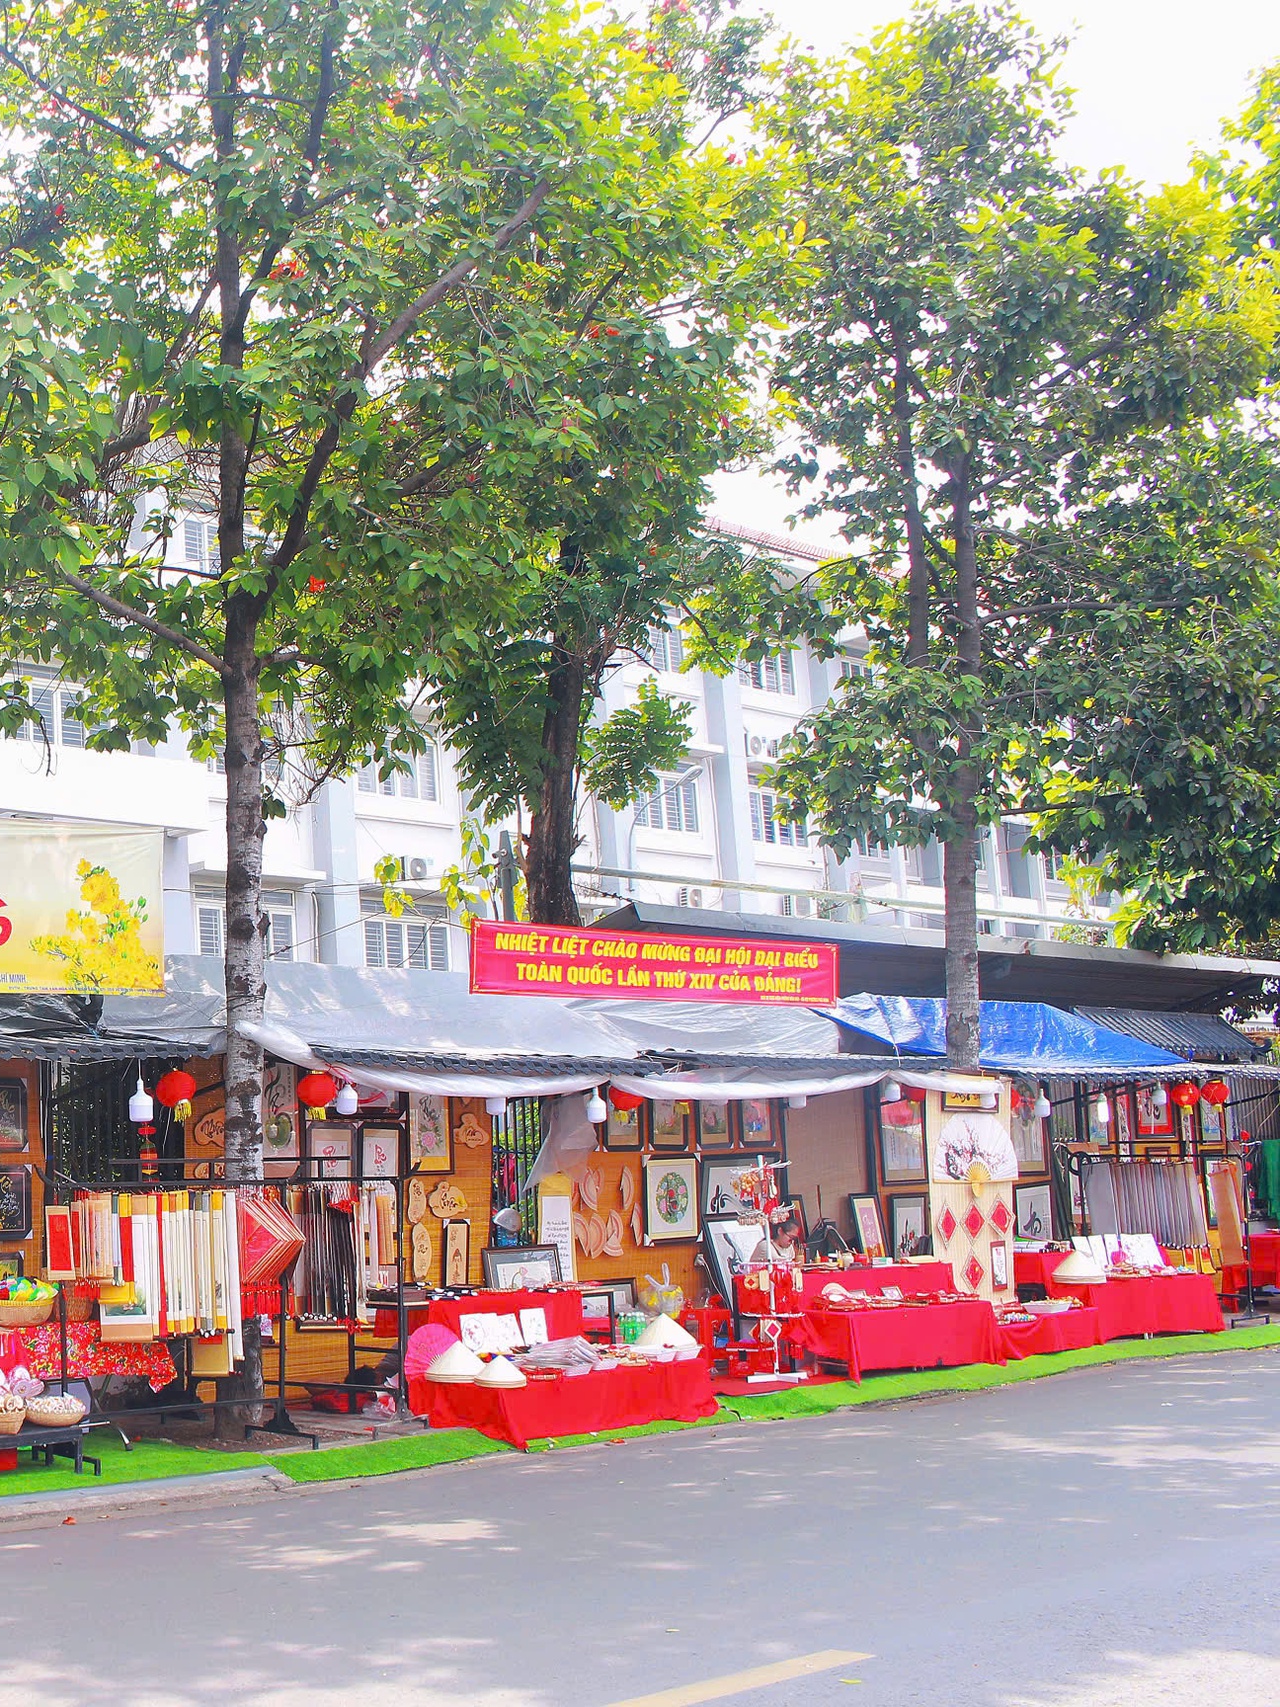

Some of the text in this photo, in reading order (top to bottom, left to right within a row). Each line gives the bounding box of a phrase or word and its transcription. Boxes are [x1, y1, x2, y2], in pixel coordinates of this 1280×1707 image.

[495, 933, 819, 969] NHIỆT LIỆT CHÀO MỪNG ĐẠI HỘI ĐẠI BIỂU
[516, 962, 802, 993] TOÀN QUỐC LẦN THỨ XIV CỦA ĐẢNG!
